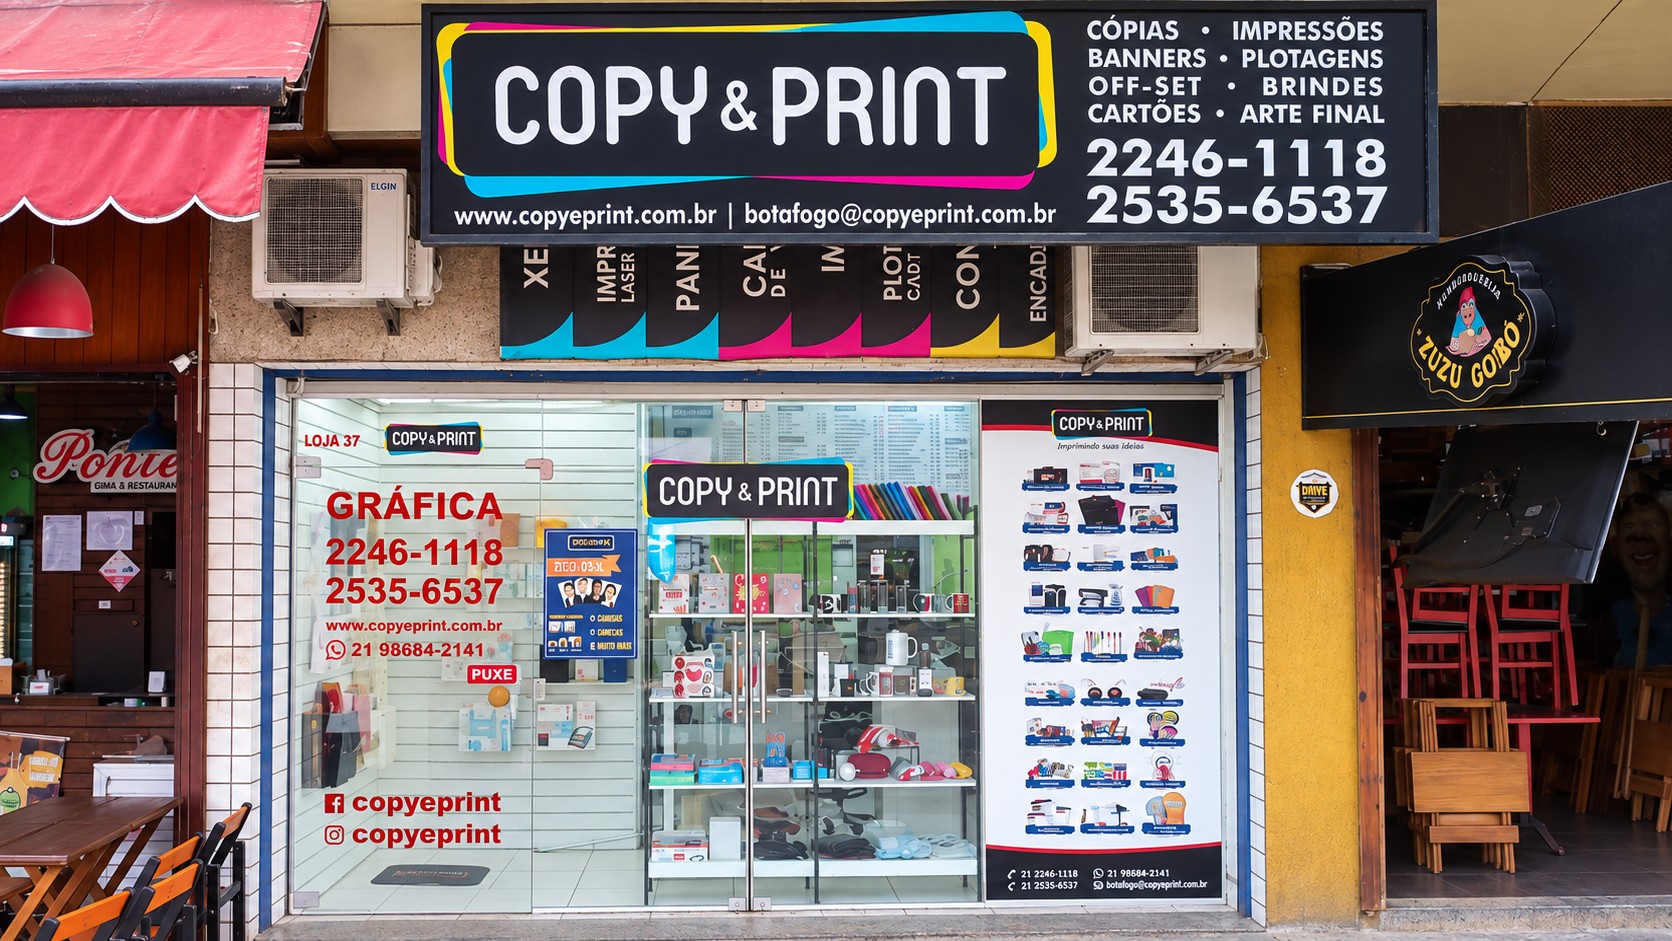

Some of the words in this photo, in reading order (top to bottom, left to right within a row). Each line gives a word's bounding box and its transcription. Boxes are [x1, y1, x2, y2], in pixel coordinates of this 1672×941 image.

[1087, 14, 1179, 42] CÓPIAS
[1232, 15, 1384, 42] IMPRESSÕES
[1088, 48, 1207, 69] BANNERS
[1242, 48, 1384, 69] PLOTAGENS
[1088, 75, 1202, 96] OFF-SET
[1262, 76, 1383, 96] BRINDES
[494, 65, 708, 146] COPY
[720, 79, 758, 132] &
[772, 66, 1007, 146] PRINT
[1087, 98, 1202, 124] CARTÕES
[1239, 104, 1302, 124] ARTE
[1312, 104, 1386, 124] FINAL
[1086, 137, 1387, 178] 2246-1118
[370, 182, 397, 191] ELGIN
[453, 203, 718, 231] www.copyeprint.com.br
[744, 202, 1058, 231] botafogo@copyeprint.com.br
[1086, 184, 1388, 225] 2535-6537
[523, 244, 549, 289] XE
[621, 252, 635, 303] LASER
[742, 244, 767, 297] CA
[770, 268, 786, 297] DE
[1418, 335, 1462, 389] ZUZU
[1471, 319, 1521, 389] GOIBÓ
[1059, 416, 1096, 431] COPY
[1096, 419, 1103, 430] &
[1104, 416, 1145, 431] PRINT
[304, 434, 340, 448] LOJA
[343, 434, 361, 447] 37
[391, 430, 428, 446] COPY
[428, 434, 437, 445] &
[437, 430, 477, 446] PRINT
[1057, 442, 1100, 452] Imprimindo
[1101, 443, 1120, 451] suas
[119, 481, 126, 490] &
[659, 476, 733, 506] COPY
[737, 482, 752, 502] &
[758, 476, 839, 506] PRINT
[326, 485, 503, 521] GRÁFICA
[326, 537, 503, 566] 2246-1118
[326, 577, 503, 605] 2535-6537
[326, 620, 503, 634] www.copyeprint.com.br
[351, 641, 372, 658] 21
[379, 641, 484, 658] 98684-2141
[471, 668, 513, 681] PUXE
[352, 791, 502, 817] copyeprint
[352, 823, 502, 849] copyeprint
[1020, 869, 1031, 878] 21
[1021, 881, 1031, 890] 21
[1034, 881, 1078, 890] 2535-6537
[1107, 869, 1117, 878] 21
